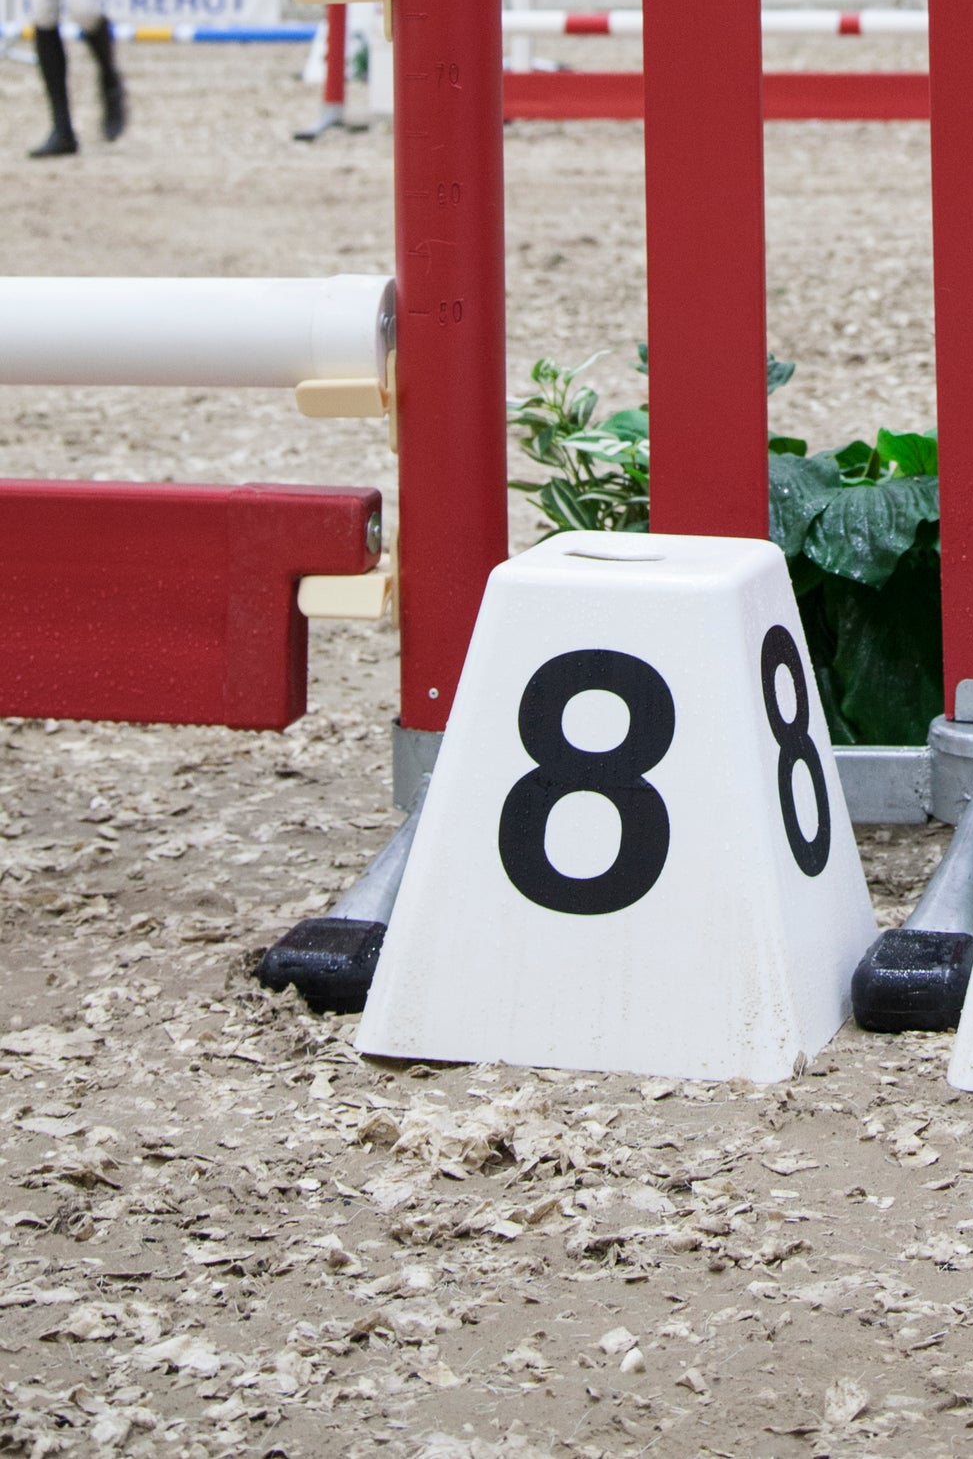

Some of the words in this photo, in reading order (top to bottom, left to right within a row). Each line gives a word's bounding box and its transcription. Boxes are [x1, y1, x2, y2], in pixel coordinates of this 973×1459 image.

[436, 63, 459, 88] 70
[438, 301, 463, 327] 50
[498, 648, 676, 916] 8
[760, 624, 831, 878] 8
